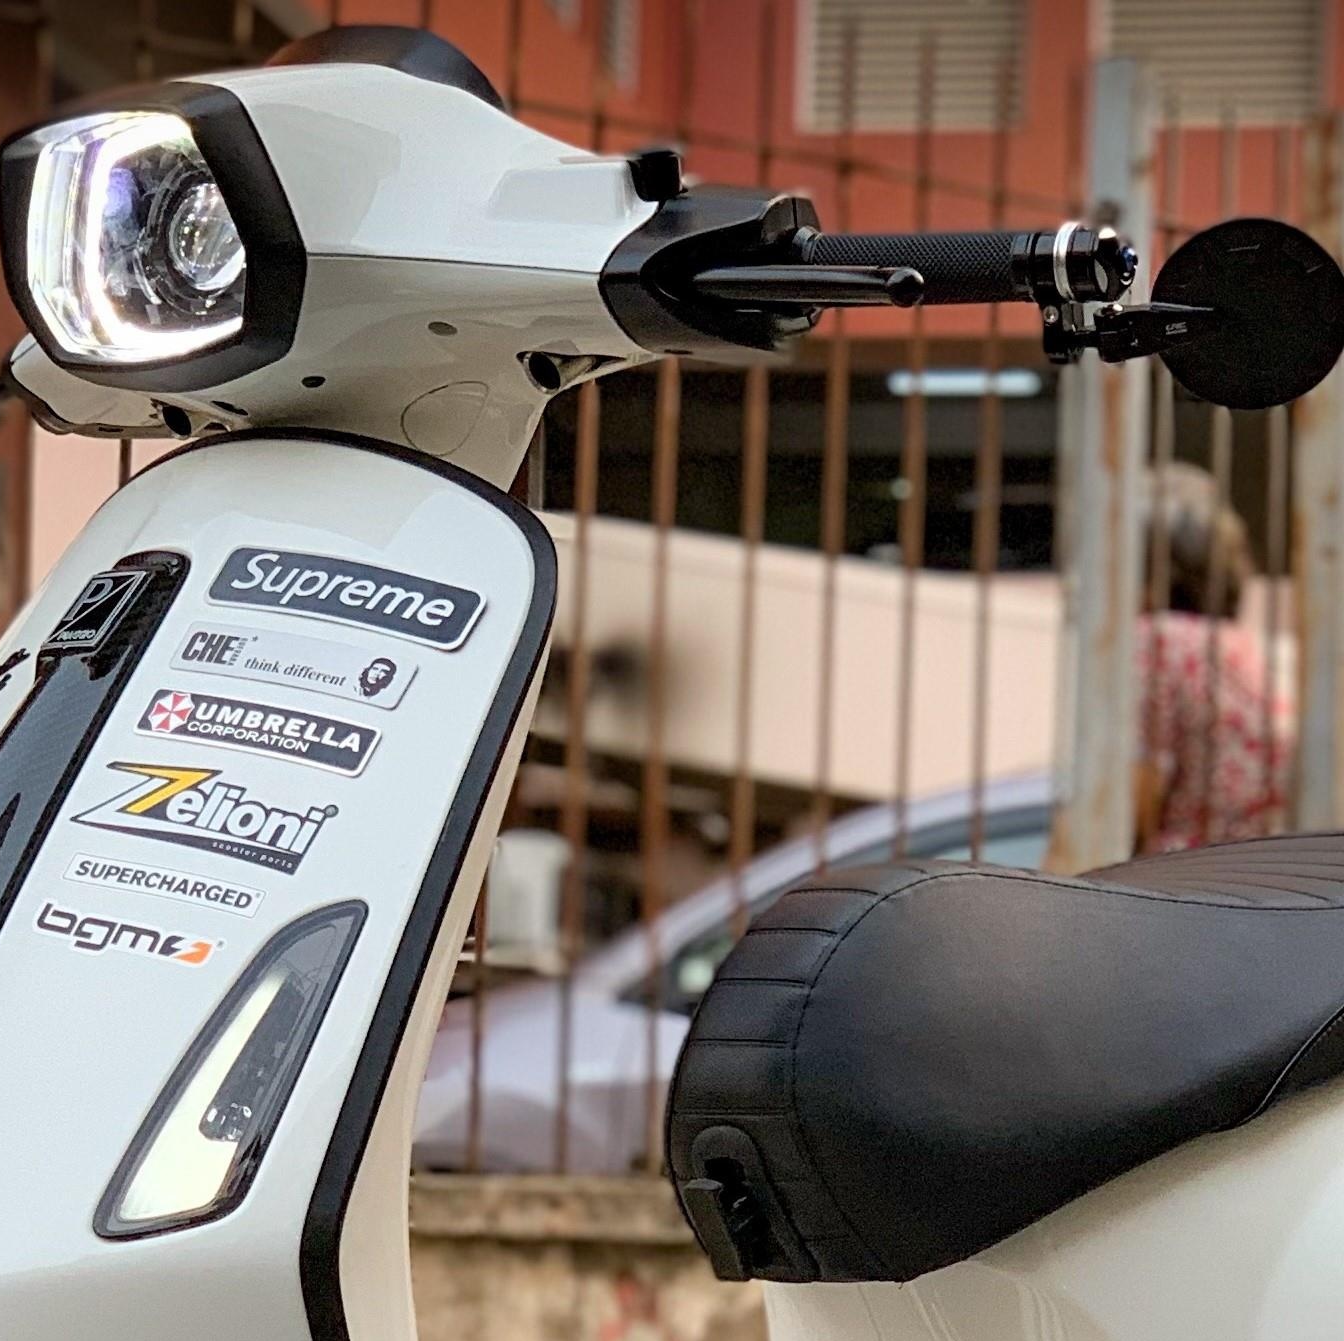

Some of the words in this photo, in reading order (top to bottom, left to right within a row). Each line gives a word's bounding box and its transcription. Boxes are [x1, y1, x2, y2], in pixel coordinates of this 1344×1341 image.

[231, 553, 454, 626] Supreme
[181, 632, 240, 665] CHE
[244, 657, 284, 675] think
[283, 663, 347, 687] different
[187, 720, 310, 753] CORPORATION
[195, 702, 361, 752] UMBRELLA
[70, 761, 339, 857] Zelioni
[211, 841, 257, 857] scooter
[259, 854, 293, 869] parts
[75, 860, 253, 909] SUPERCHARGED
